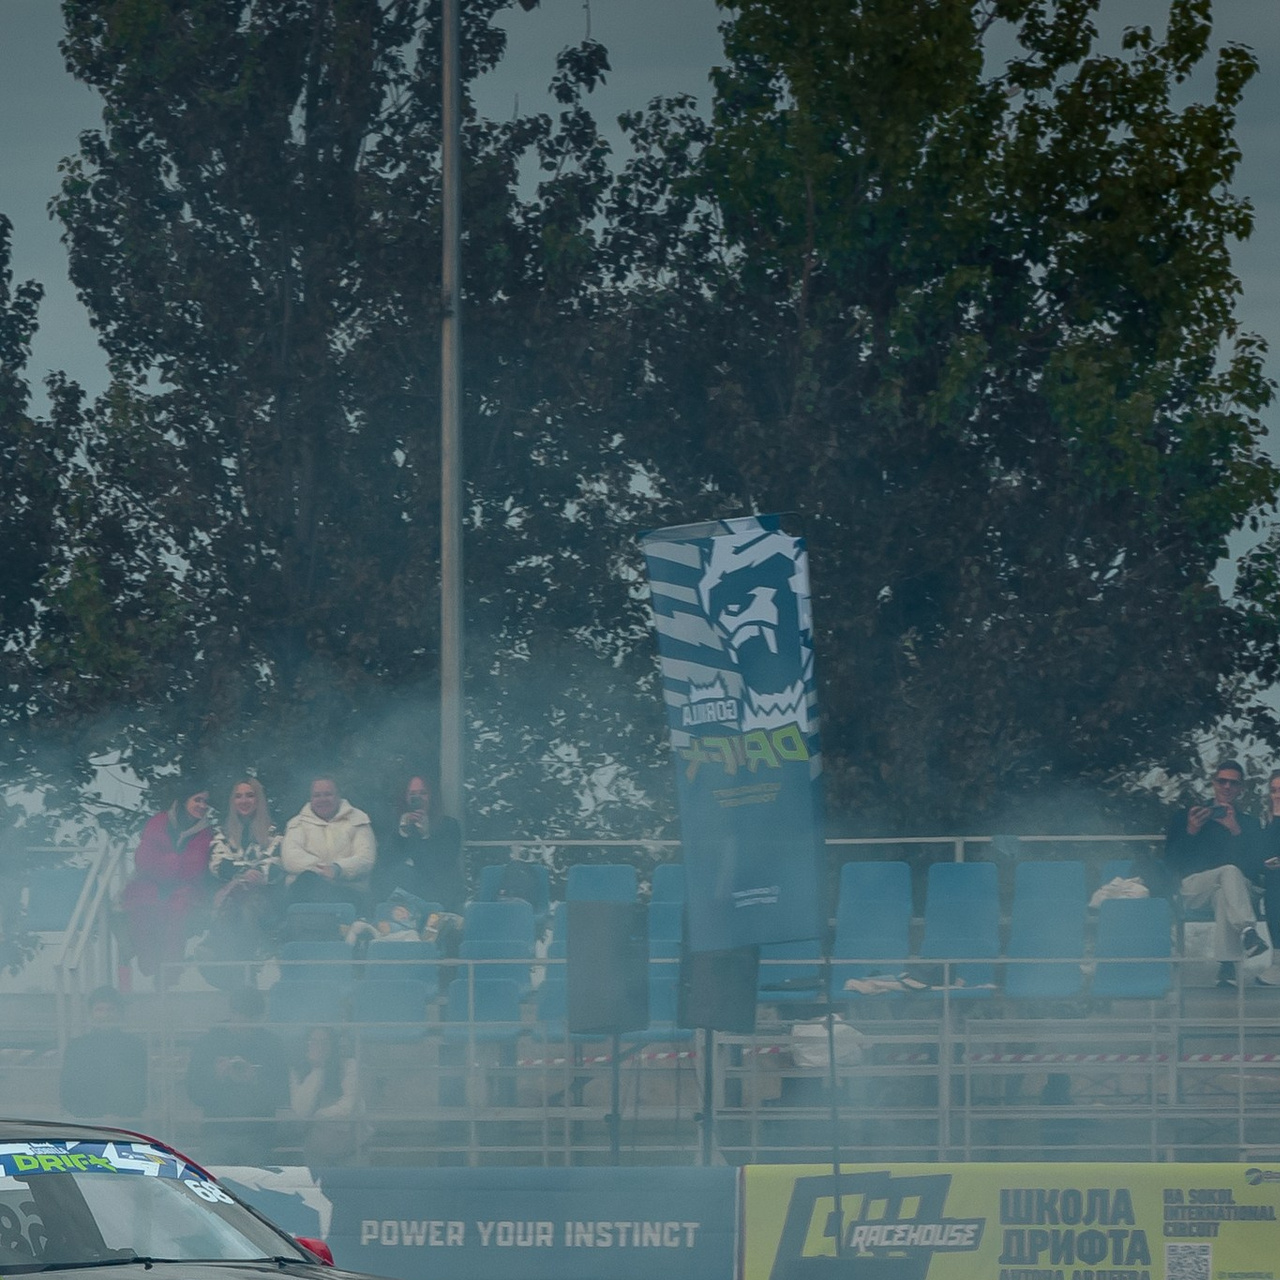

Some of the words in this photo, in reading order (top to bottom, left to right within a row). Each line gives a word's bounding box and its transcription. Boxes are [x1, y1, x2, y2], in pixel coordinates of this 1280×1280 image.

[12, 1153, 117, 1173] DRIFT
[184, 1179, 235, 1205] 68
[1000, 1188, 1135, 1225] ШКОЛА
[359, 1220, 465, 1246] POWER
[476, 1221, 554, 1247] YOUR
[565, 1221, 701, 1248] INSTINCT
[849, 1223, 979, 1252] RACEHOUSE
[998, 1229, 1152, 1265] ДРИФТА
